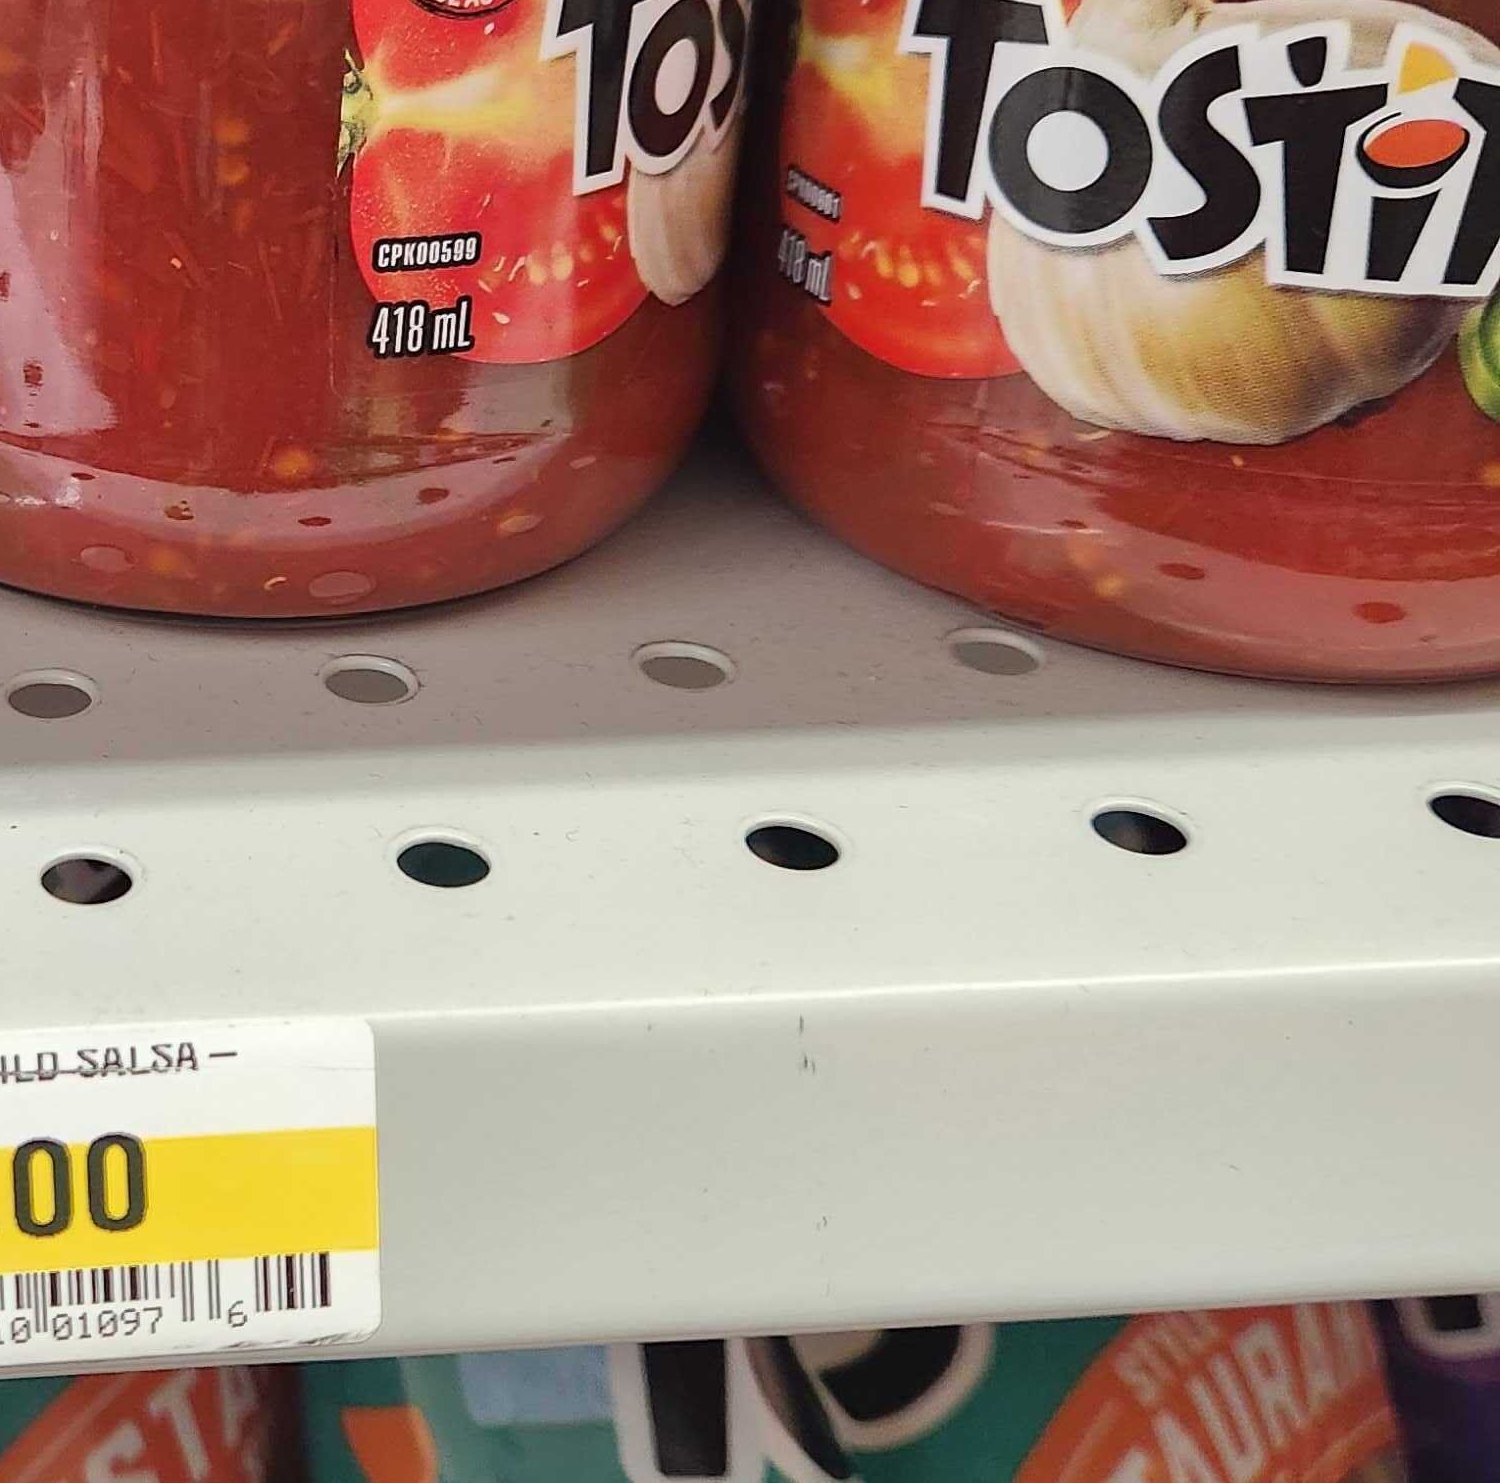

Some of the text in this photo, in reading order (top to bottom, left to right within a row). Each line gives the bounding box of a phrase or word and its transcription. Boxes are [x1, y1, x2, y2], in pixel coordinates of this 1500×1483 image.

[377, 236, 478, 268] CPK00599
[371, 300, 472, 354] 418 mL
[77, 1041, 199, 1078] SALSA
[51, 1306, 163, 1340] 01097
[226, 1299, 249, 1328] 6
